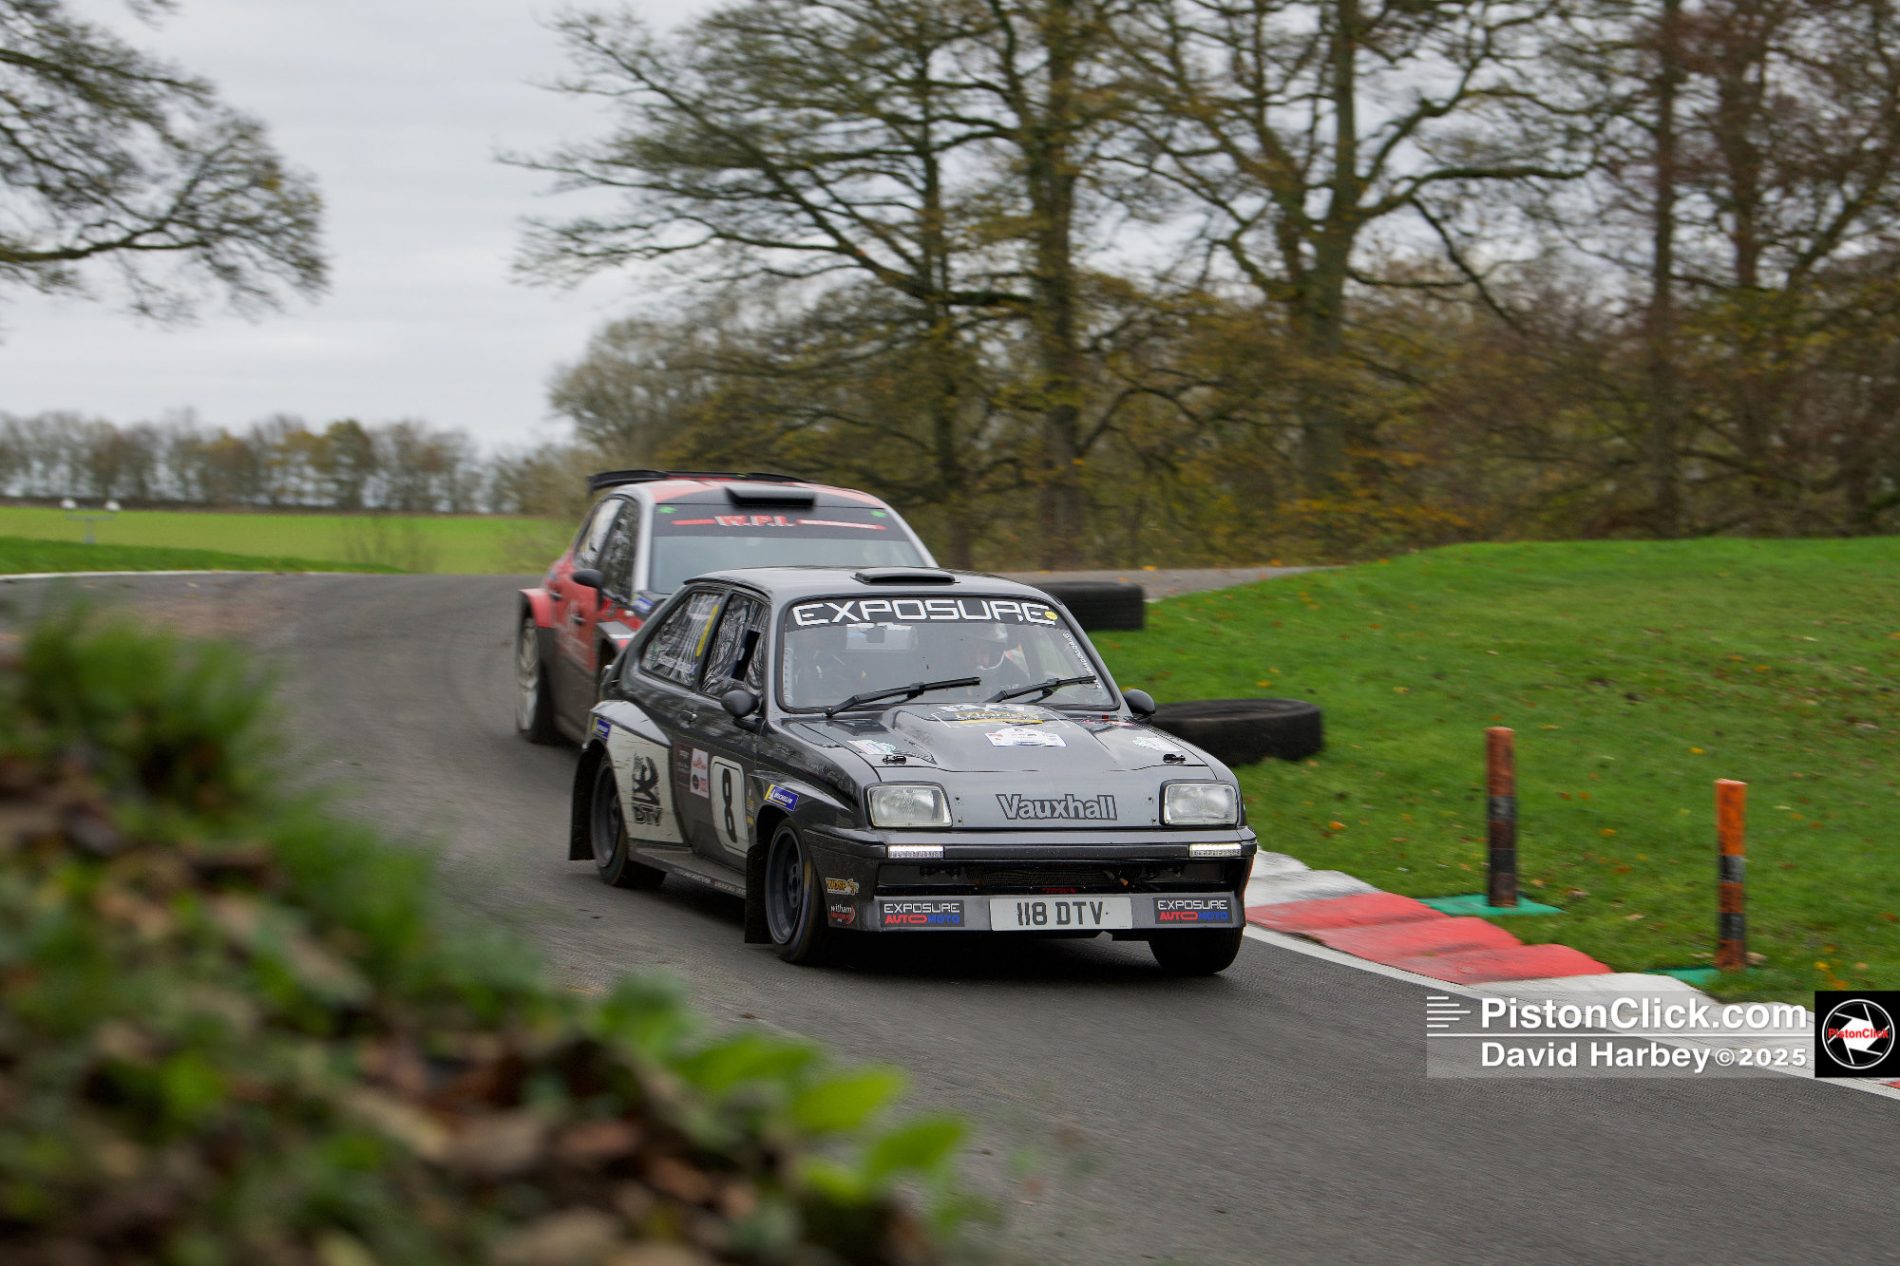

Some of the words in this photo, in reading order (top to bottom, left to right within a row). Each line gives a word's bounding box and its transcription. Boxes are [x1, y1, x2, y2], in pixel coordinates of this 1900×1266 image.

[793, 600, 1056, 627] EXPOSURE
[722, 768, 737, 844] 8
[995, 793, 1118, 821] Vauxhall
[883, 903, 960, 914] EXPOSURE
[1017, 902, 1048, 925] 118
[1056, 901, 1104, 925] DTV
[1157, 899, 1228, 910] EXPOSURE
